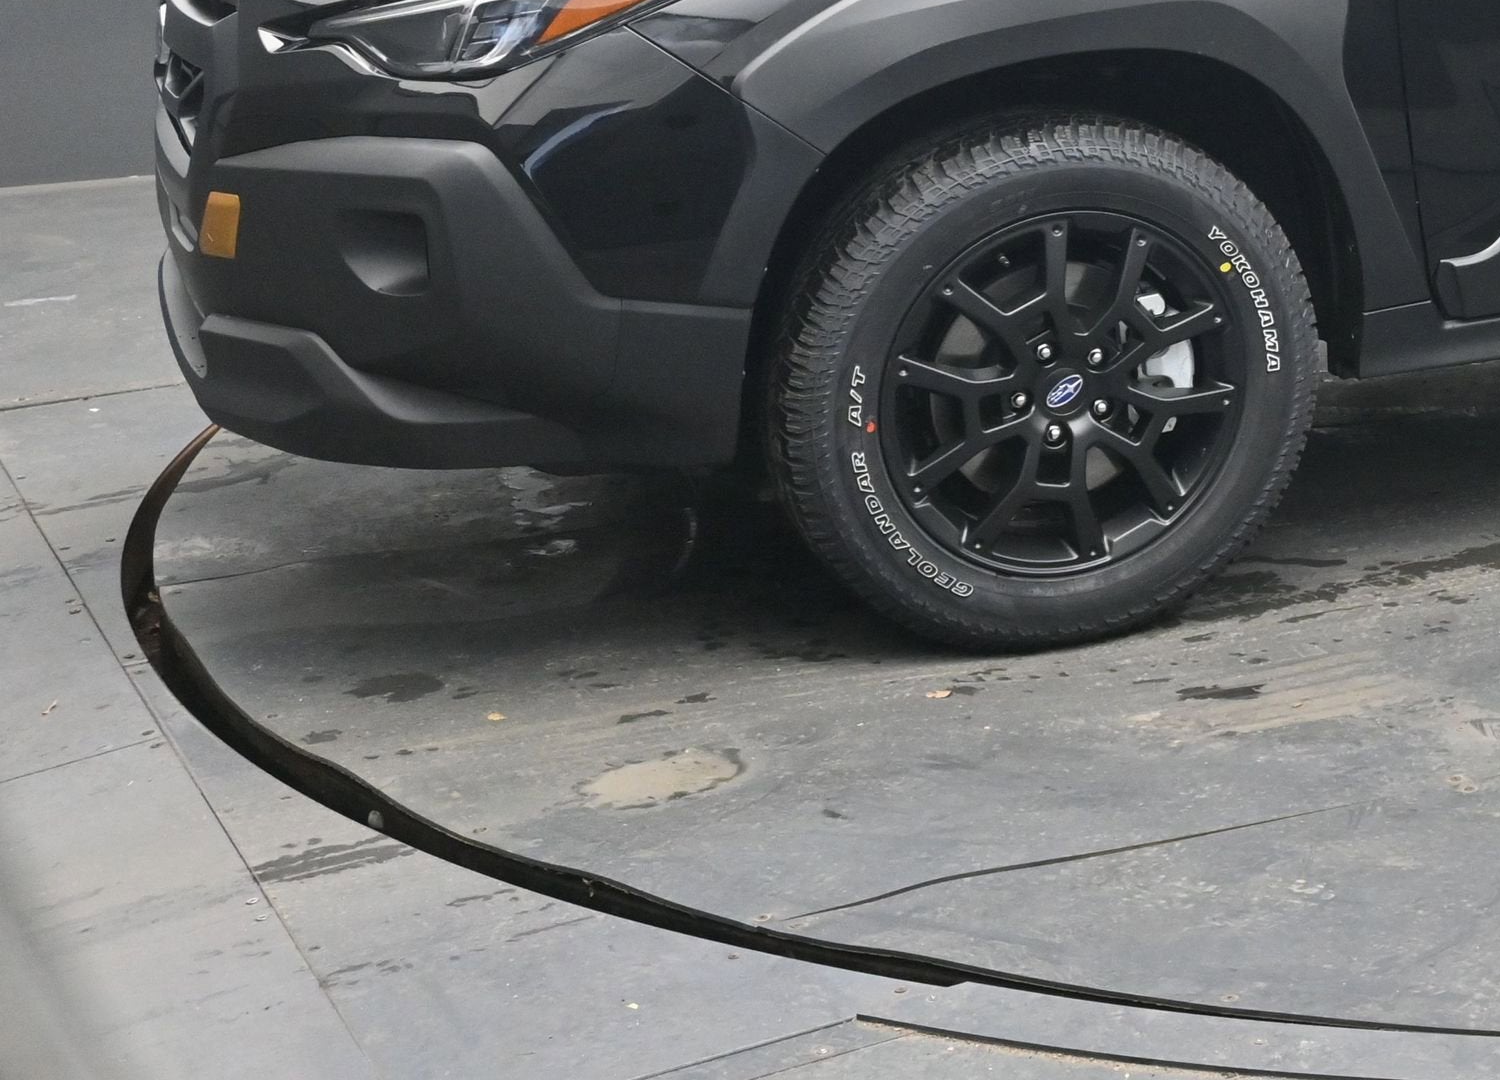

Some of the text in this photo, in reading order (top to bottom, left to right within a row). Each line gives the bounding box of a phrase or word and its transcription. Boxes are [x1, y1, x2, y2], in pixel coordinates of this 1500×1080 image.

[1207, 226, 1281, 373] YOKOHAMA
[848, 365, 974, 598] GEOLANDAR A/T
